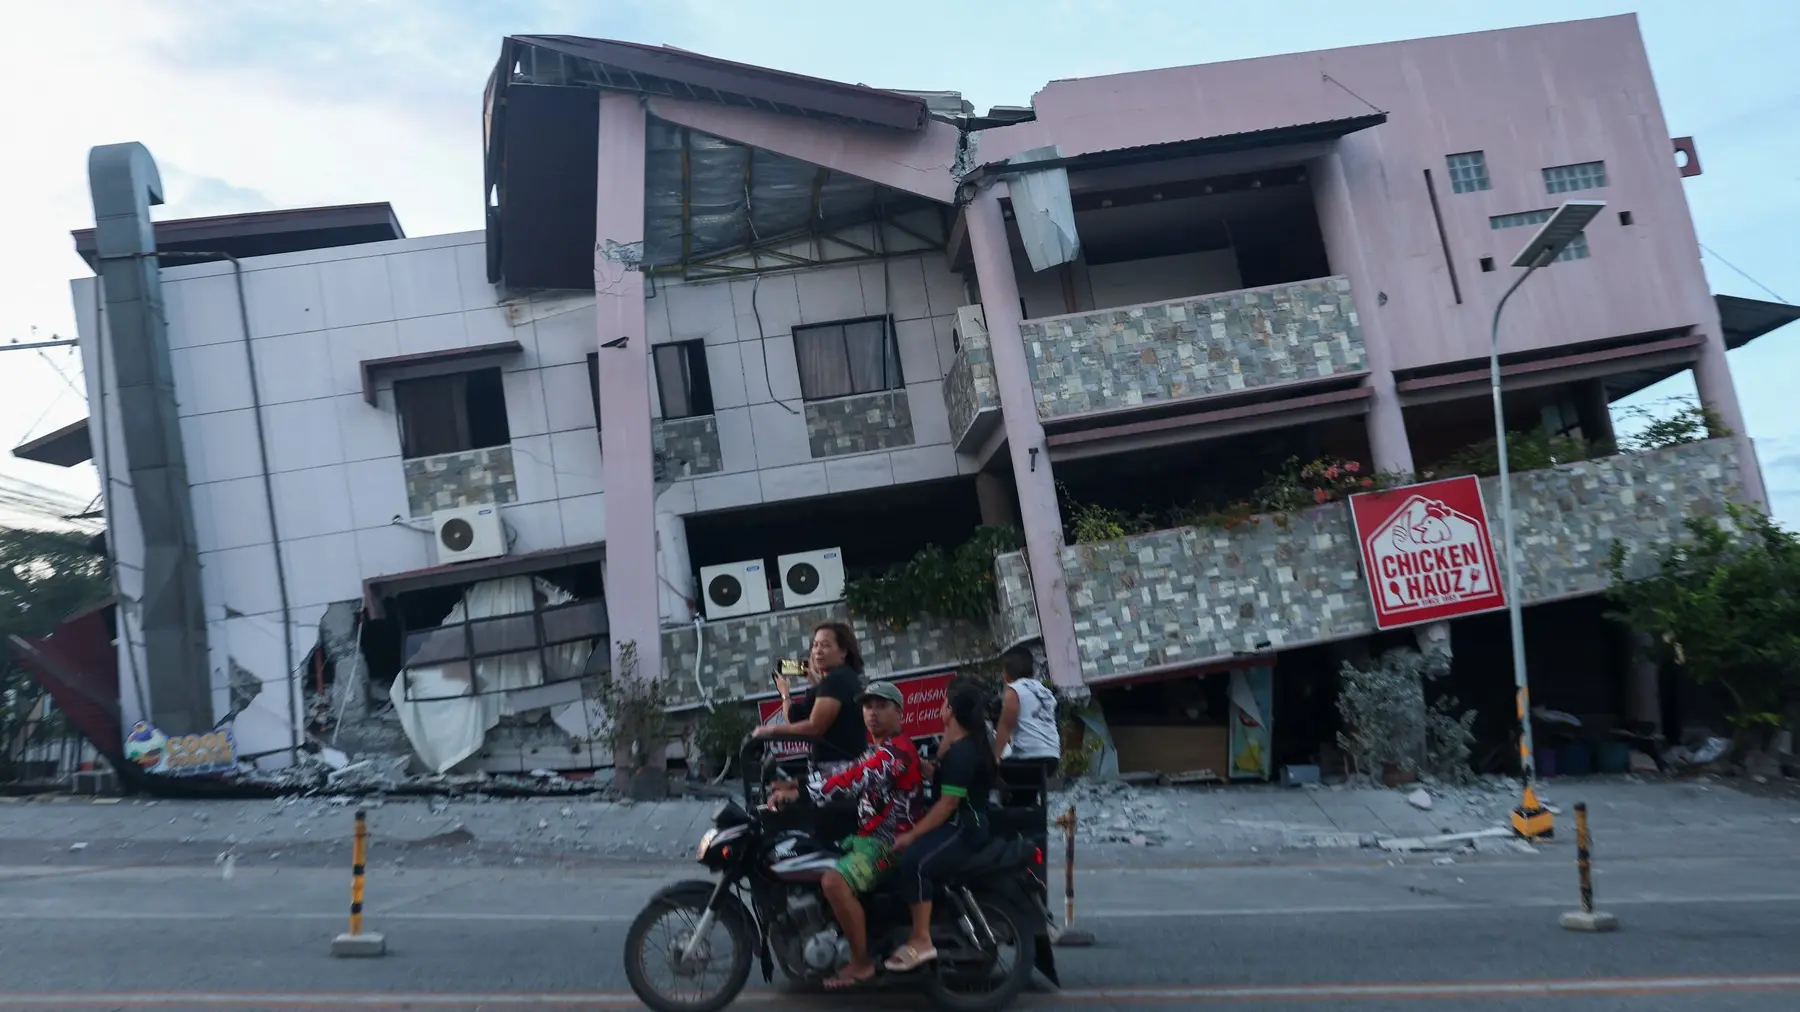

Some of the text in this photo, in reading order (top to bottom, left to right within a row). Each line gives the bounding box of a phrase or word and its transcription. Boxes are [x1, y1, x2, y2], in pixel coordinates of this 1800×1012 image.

[1382, 542, 1479, 579] CHICKEN
[1406, 569, 1465, 600] HAUZ
[907, 687, 947, 704] GENSAN
